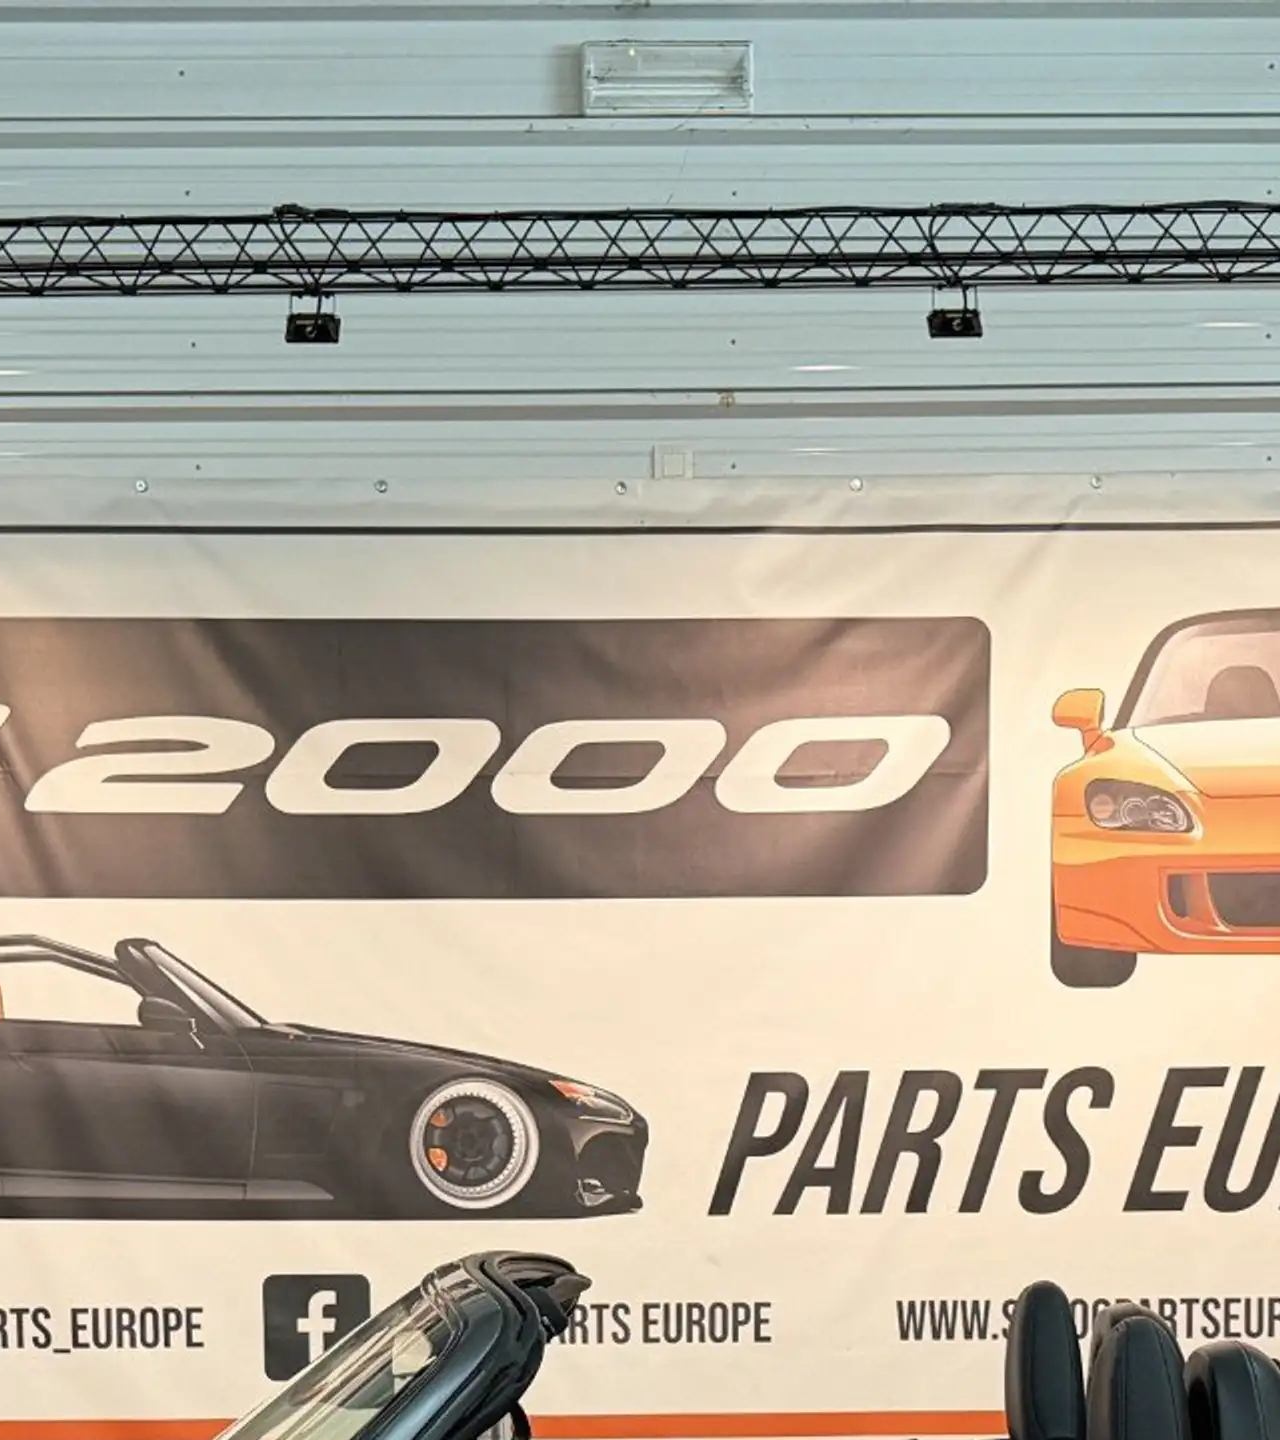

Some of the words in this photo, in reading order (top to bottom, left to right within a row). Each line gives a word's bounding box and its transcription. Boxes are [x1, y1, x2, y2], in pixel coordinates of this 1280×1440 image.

[707, 1065, 1116, 1217] PARTS
[552, 1302, 631, 1345] RTS
[641, 1301, 773, 1345] EUROPE
